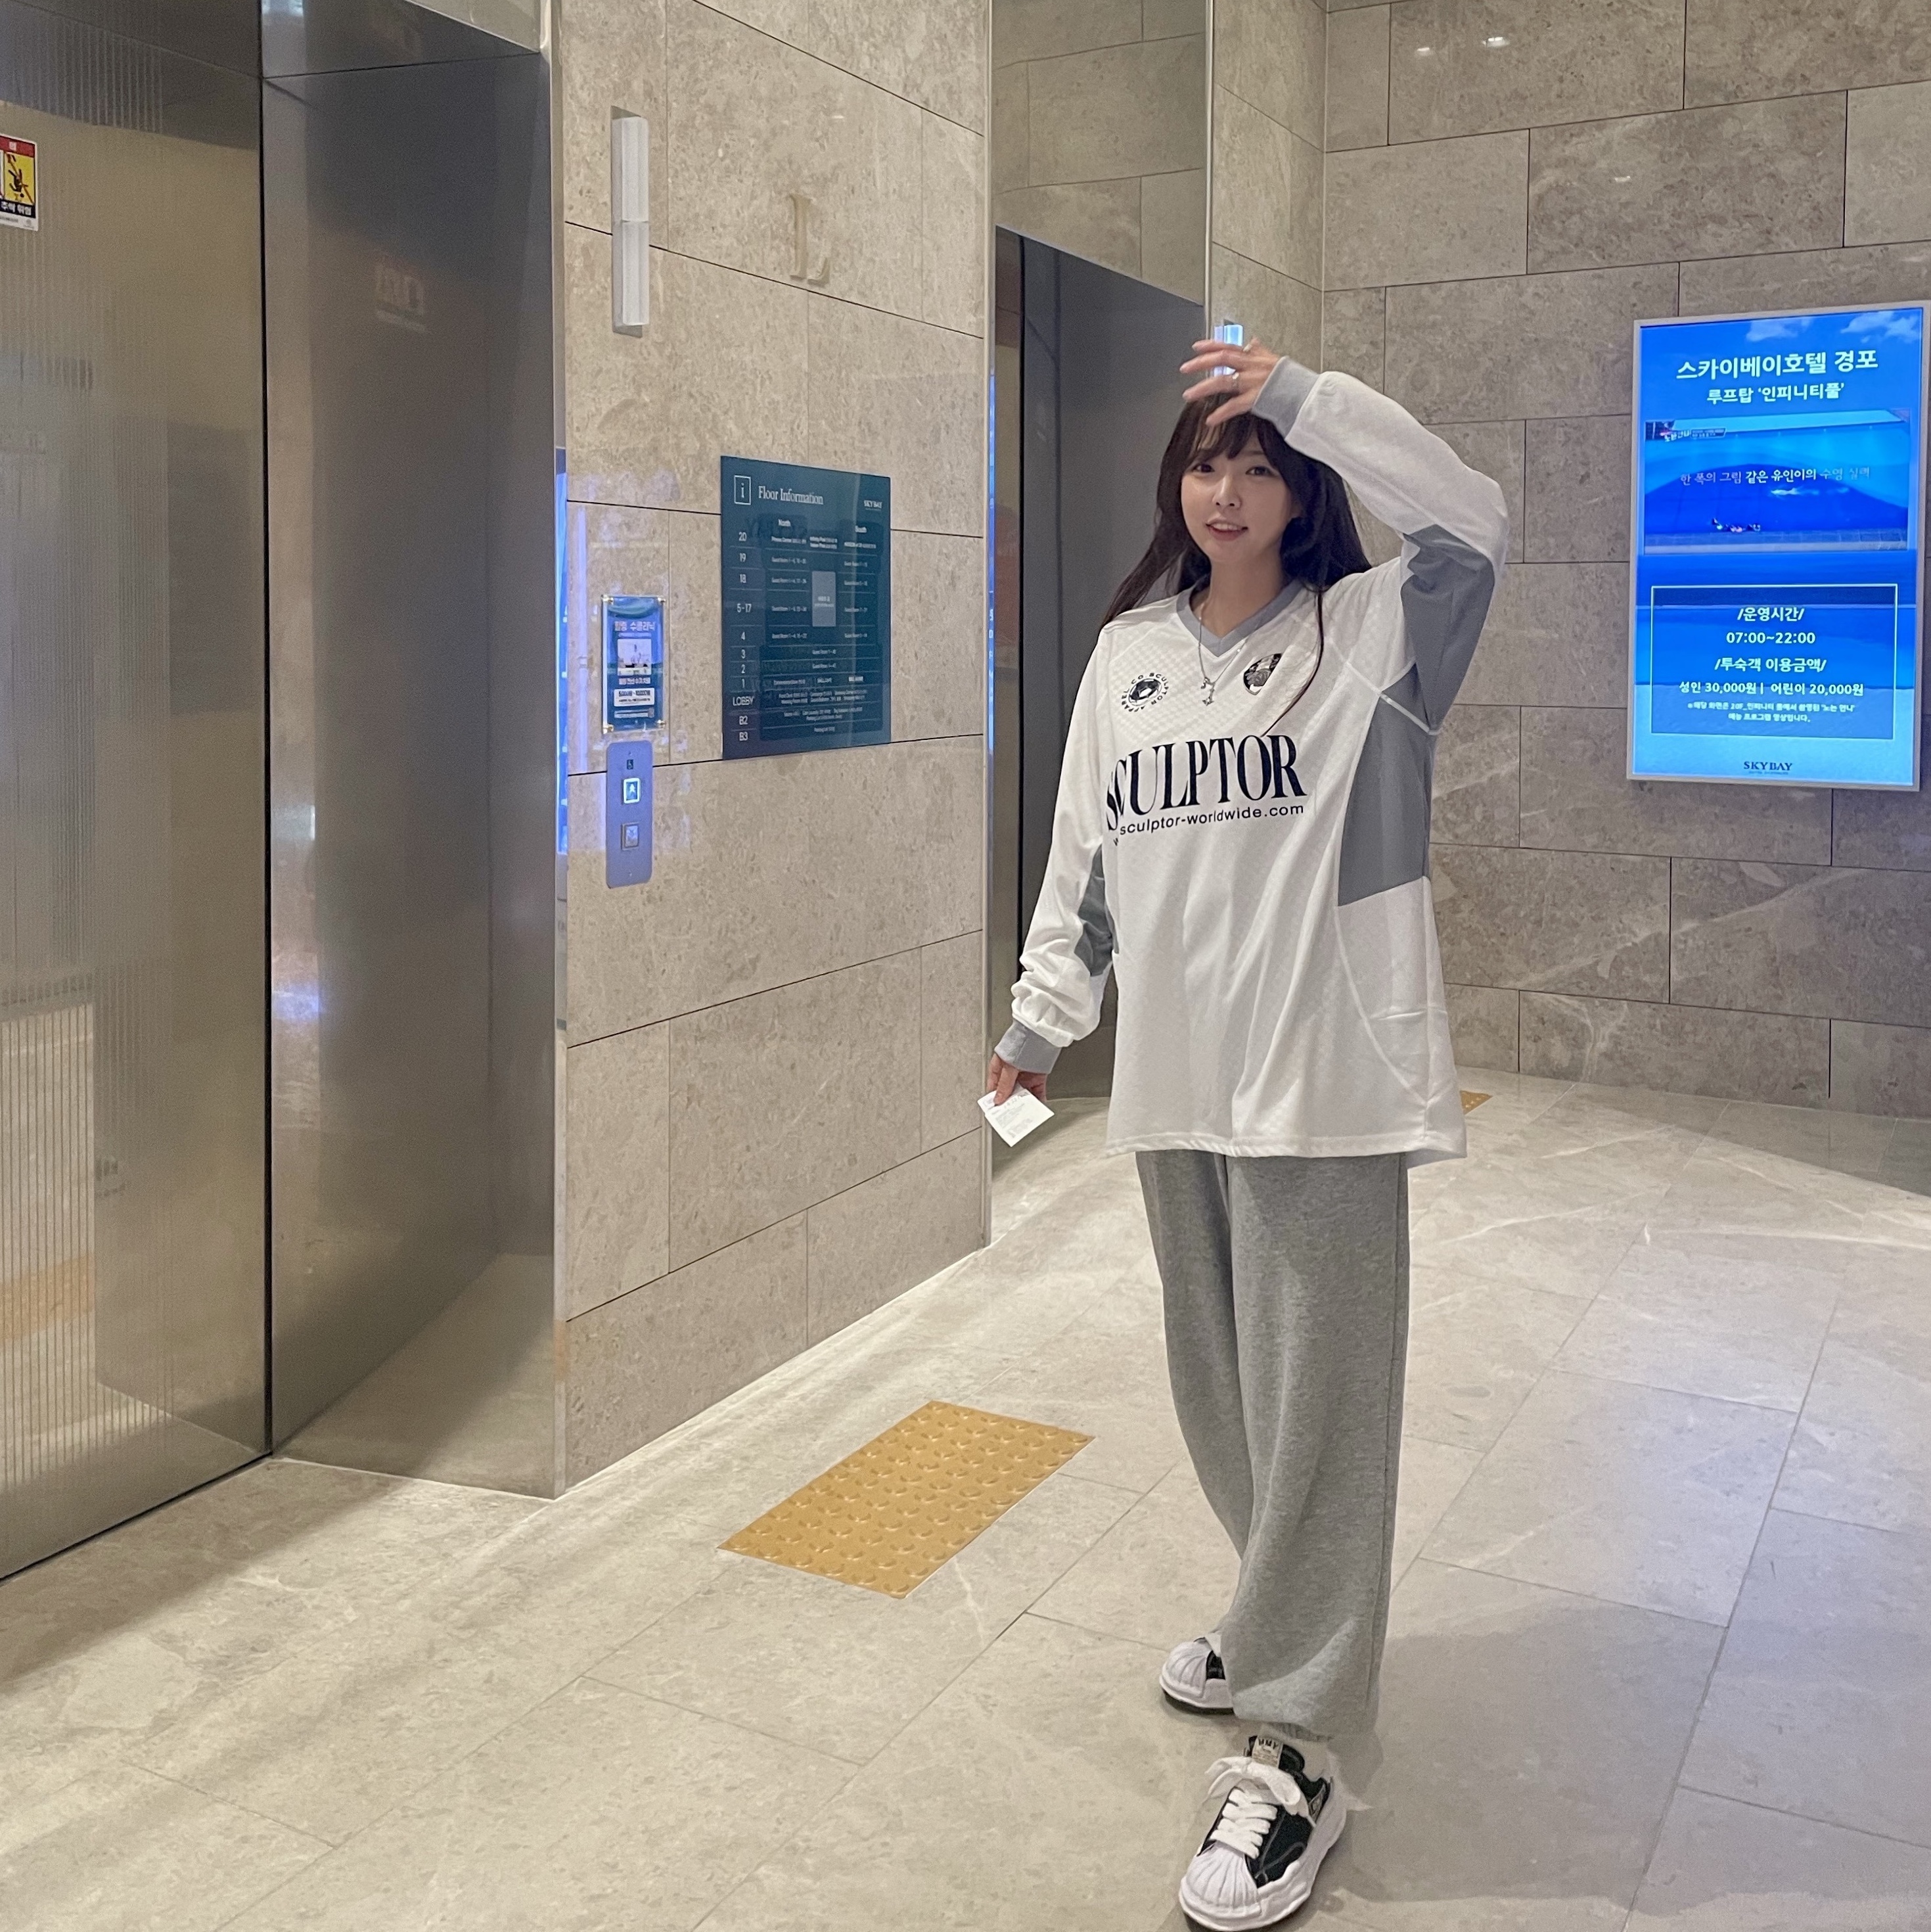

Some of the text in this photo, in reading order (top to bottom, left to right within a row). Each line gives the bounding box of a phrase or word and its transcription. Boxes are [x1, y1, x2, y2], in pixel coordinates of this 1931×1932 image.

[1676, 350, 1878, 380] 스카이베이호텔 경포
[1707, 387, 1753, 404] 루프탑
[1746, 469, 1768, 484] 같은
[1771, 468, 1816, 482] 유인이의
[758, 486, 824, 505] Floor Information
[738, 532, 747, 541] 20
[739, 553, 746, 563] 19
[737, 603, 752, 612] 5-17
[741, 632, 746, 640] 4
[1726, 632, 1815, 644] 07:00~22:00
[741, 649, 746, 659] 3
[741, 664, 746, 674] 2
[1679, 681, 1701, 694] 성인
[1704, 682, 1757, 695] 30,000원
[1771, 683, 1806, 695] 어린이
[1809, 683, 1863, 697] 20,000원
[733, 696, 754, 706] LOBBY
[738, 716, 748, 725] B2
[739, 731, 748, 741] B3
